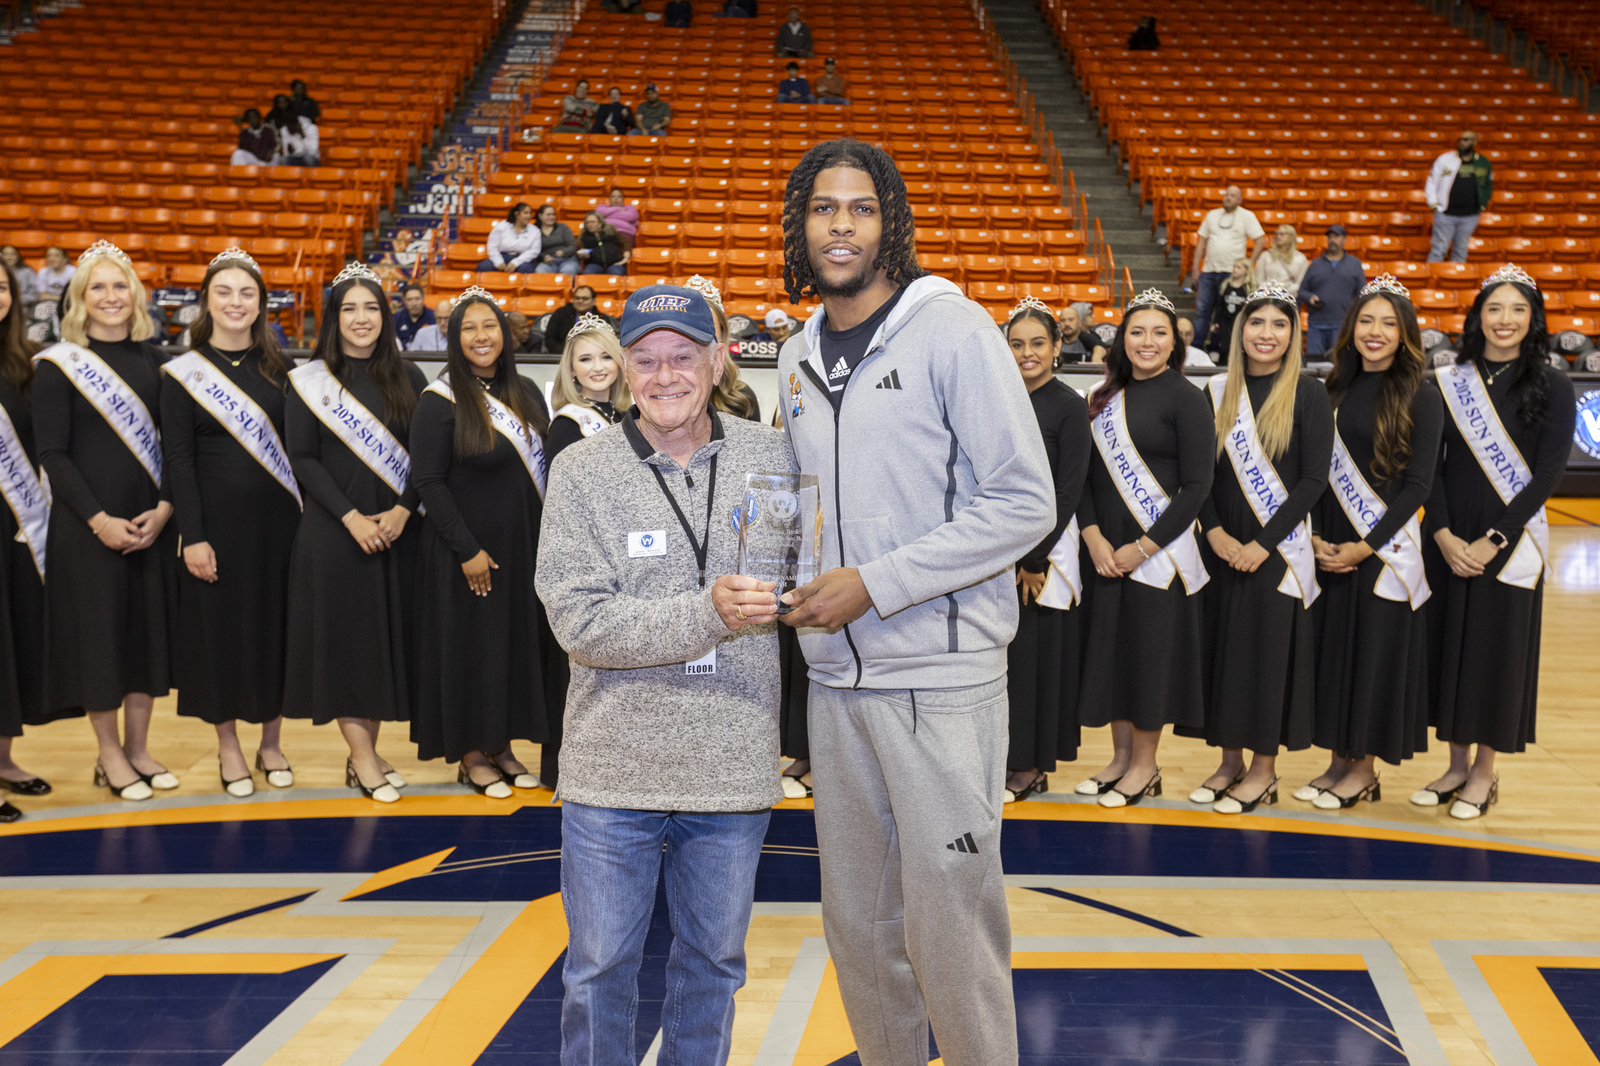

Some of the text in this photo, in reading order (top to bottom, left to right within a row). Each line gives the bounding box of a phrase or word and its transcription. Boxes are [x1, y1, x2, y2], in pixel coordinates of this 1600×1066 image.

[637, 295, 691, 309] UTEP
[739, 342, 778, 354] POSS
[77, 363, 111, 393] 2025
[108, 394, 139, 426] SUN
[829, 368, 851, 380] adidas
[205, 383, 239, 412] 2025
[235, 409, 267, 442] SUN
[332, 403, 361, 431] 2025
[356, 427, 388, 457] SUN
[1453, 378, 1475, 406] 2025
[1466, 407, 1492, 440] SUN
[1232, 430, 1253, 464] SUN
[1102, 420, 1119, 451] SUN
[1114, 452, 1162, 522] PRINCESS
[687, 664, 713, 674] FLOOR
